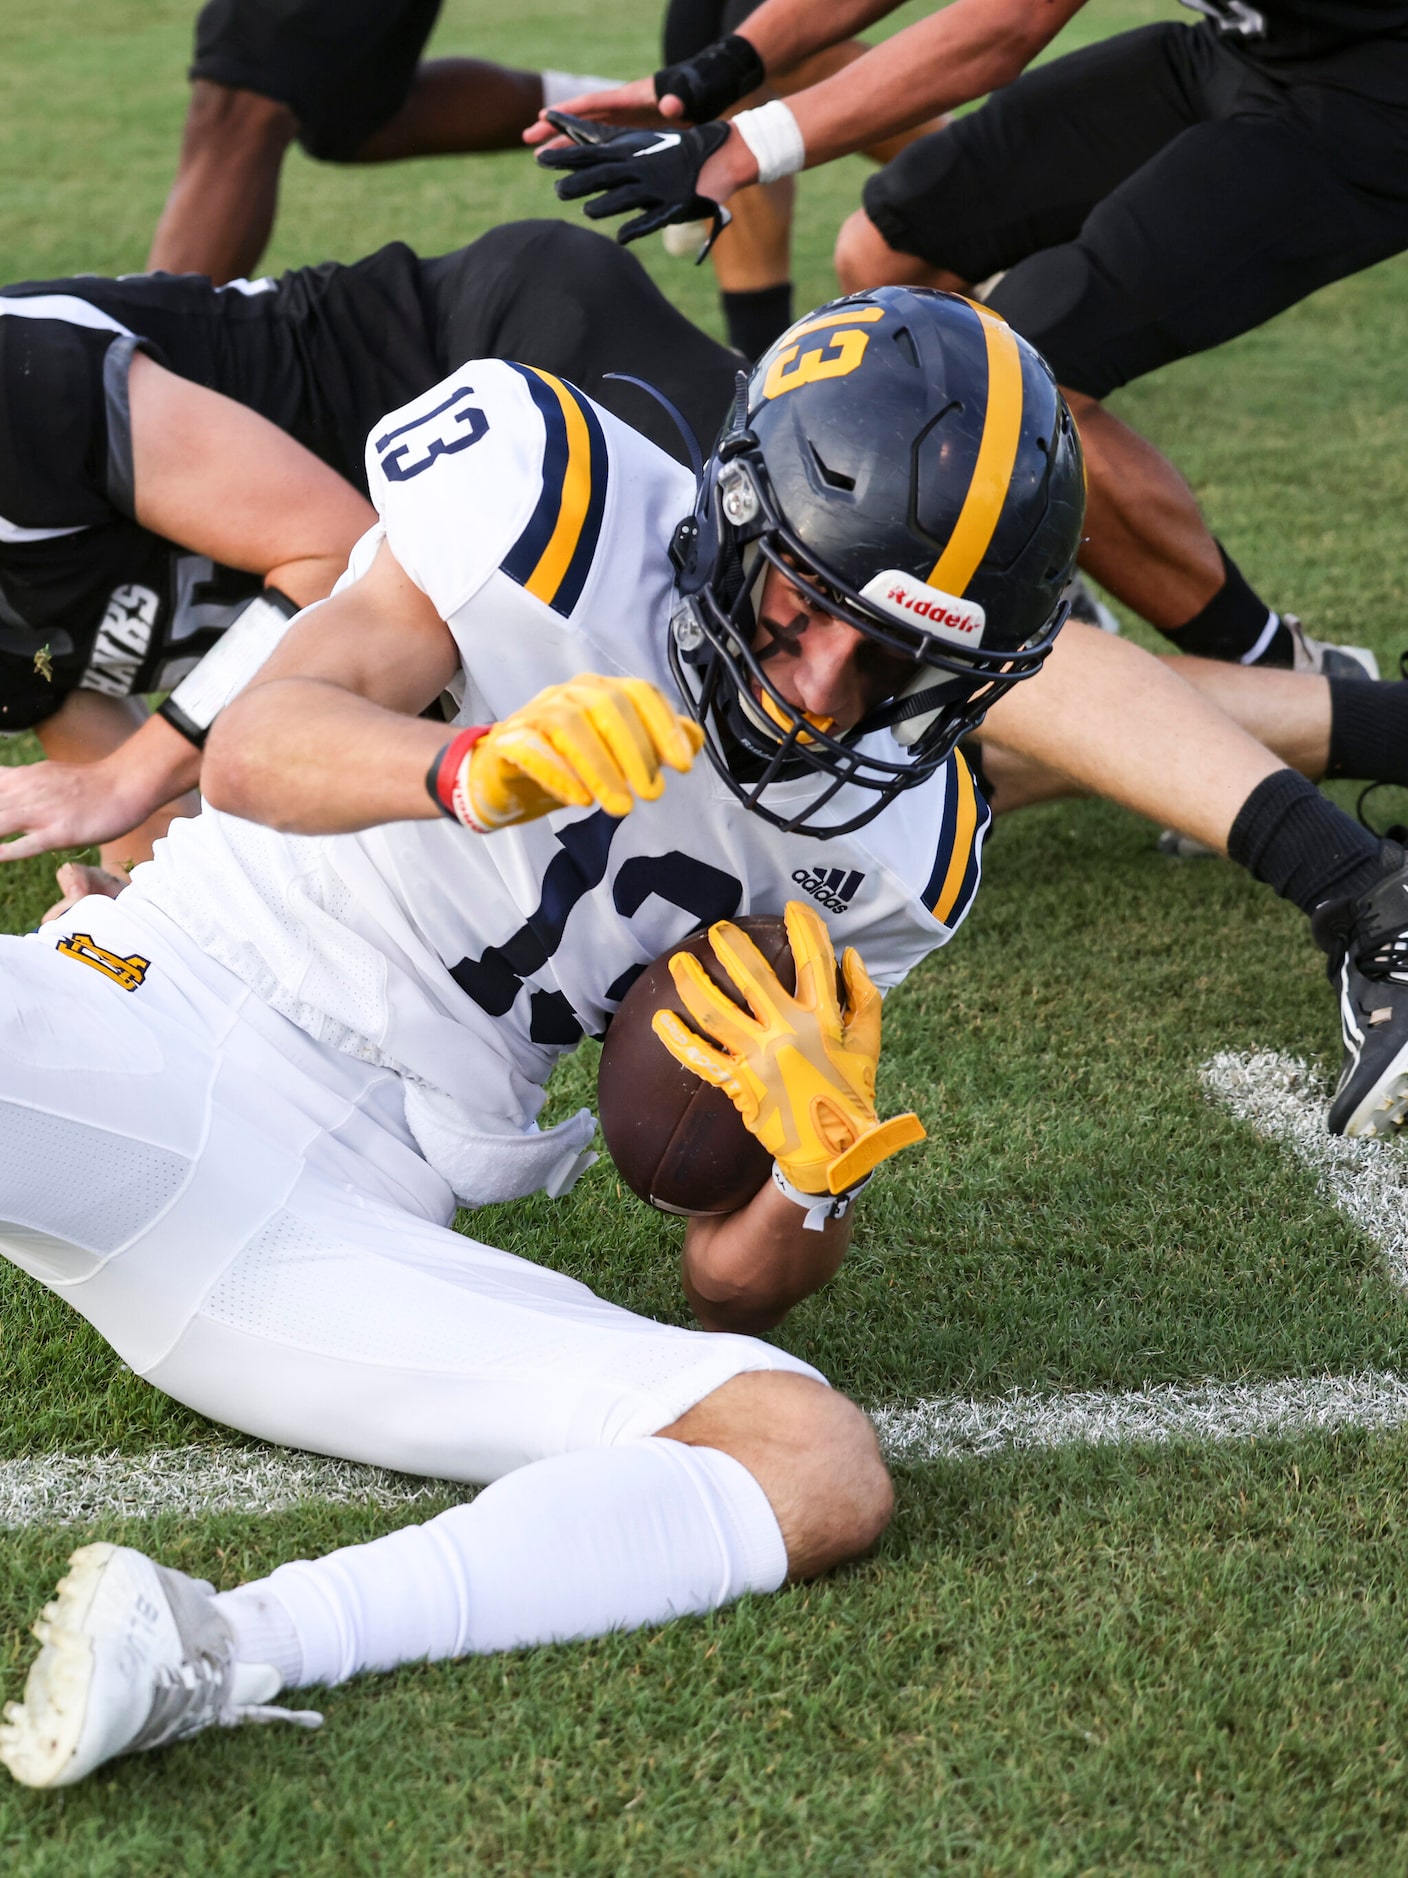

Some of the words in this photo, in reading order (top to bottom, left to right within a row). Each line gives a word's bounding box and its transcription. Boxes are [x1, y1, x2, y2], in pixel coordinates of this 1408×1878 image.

[762, 307, 886, 402] 13
[375, 386, 490, 482] 13
[791, 869, 849, 914] adidas
